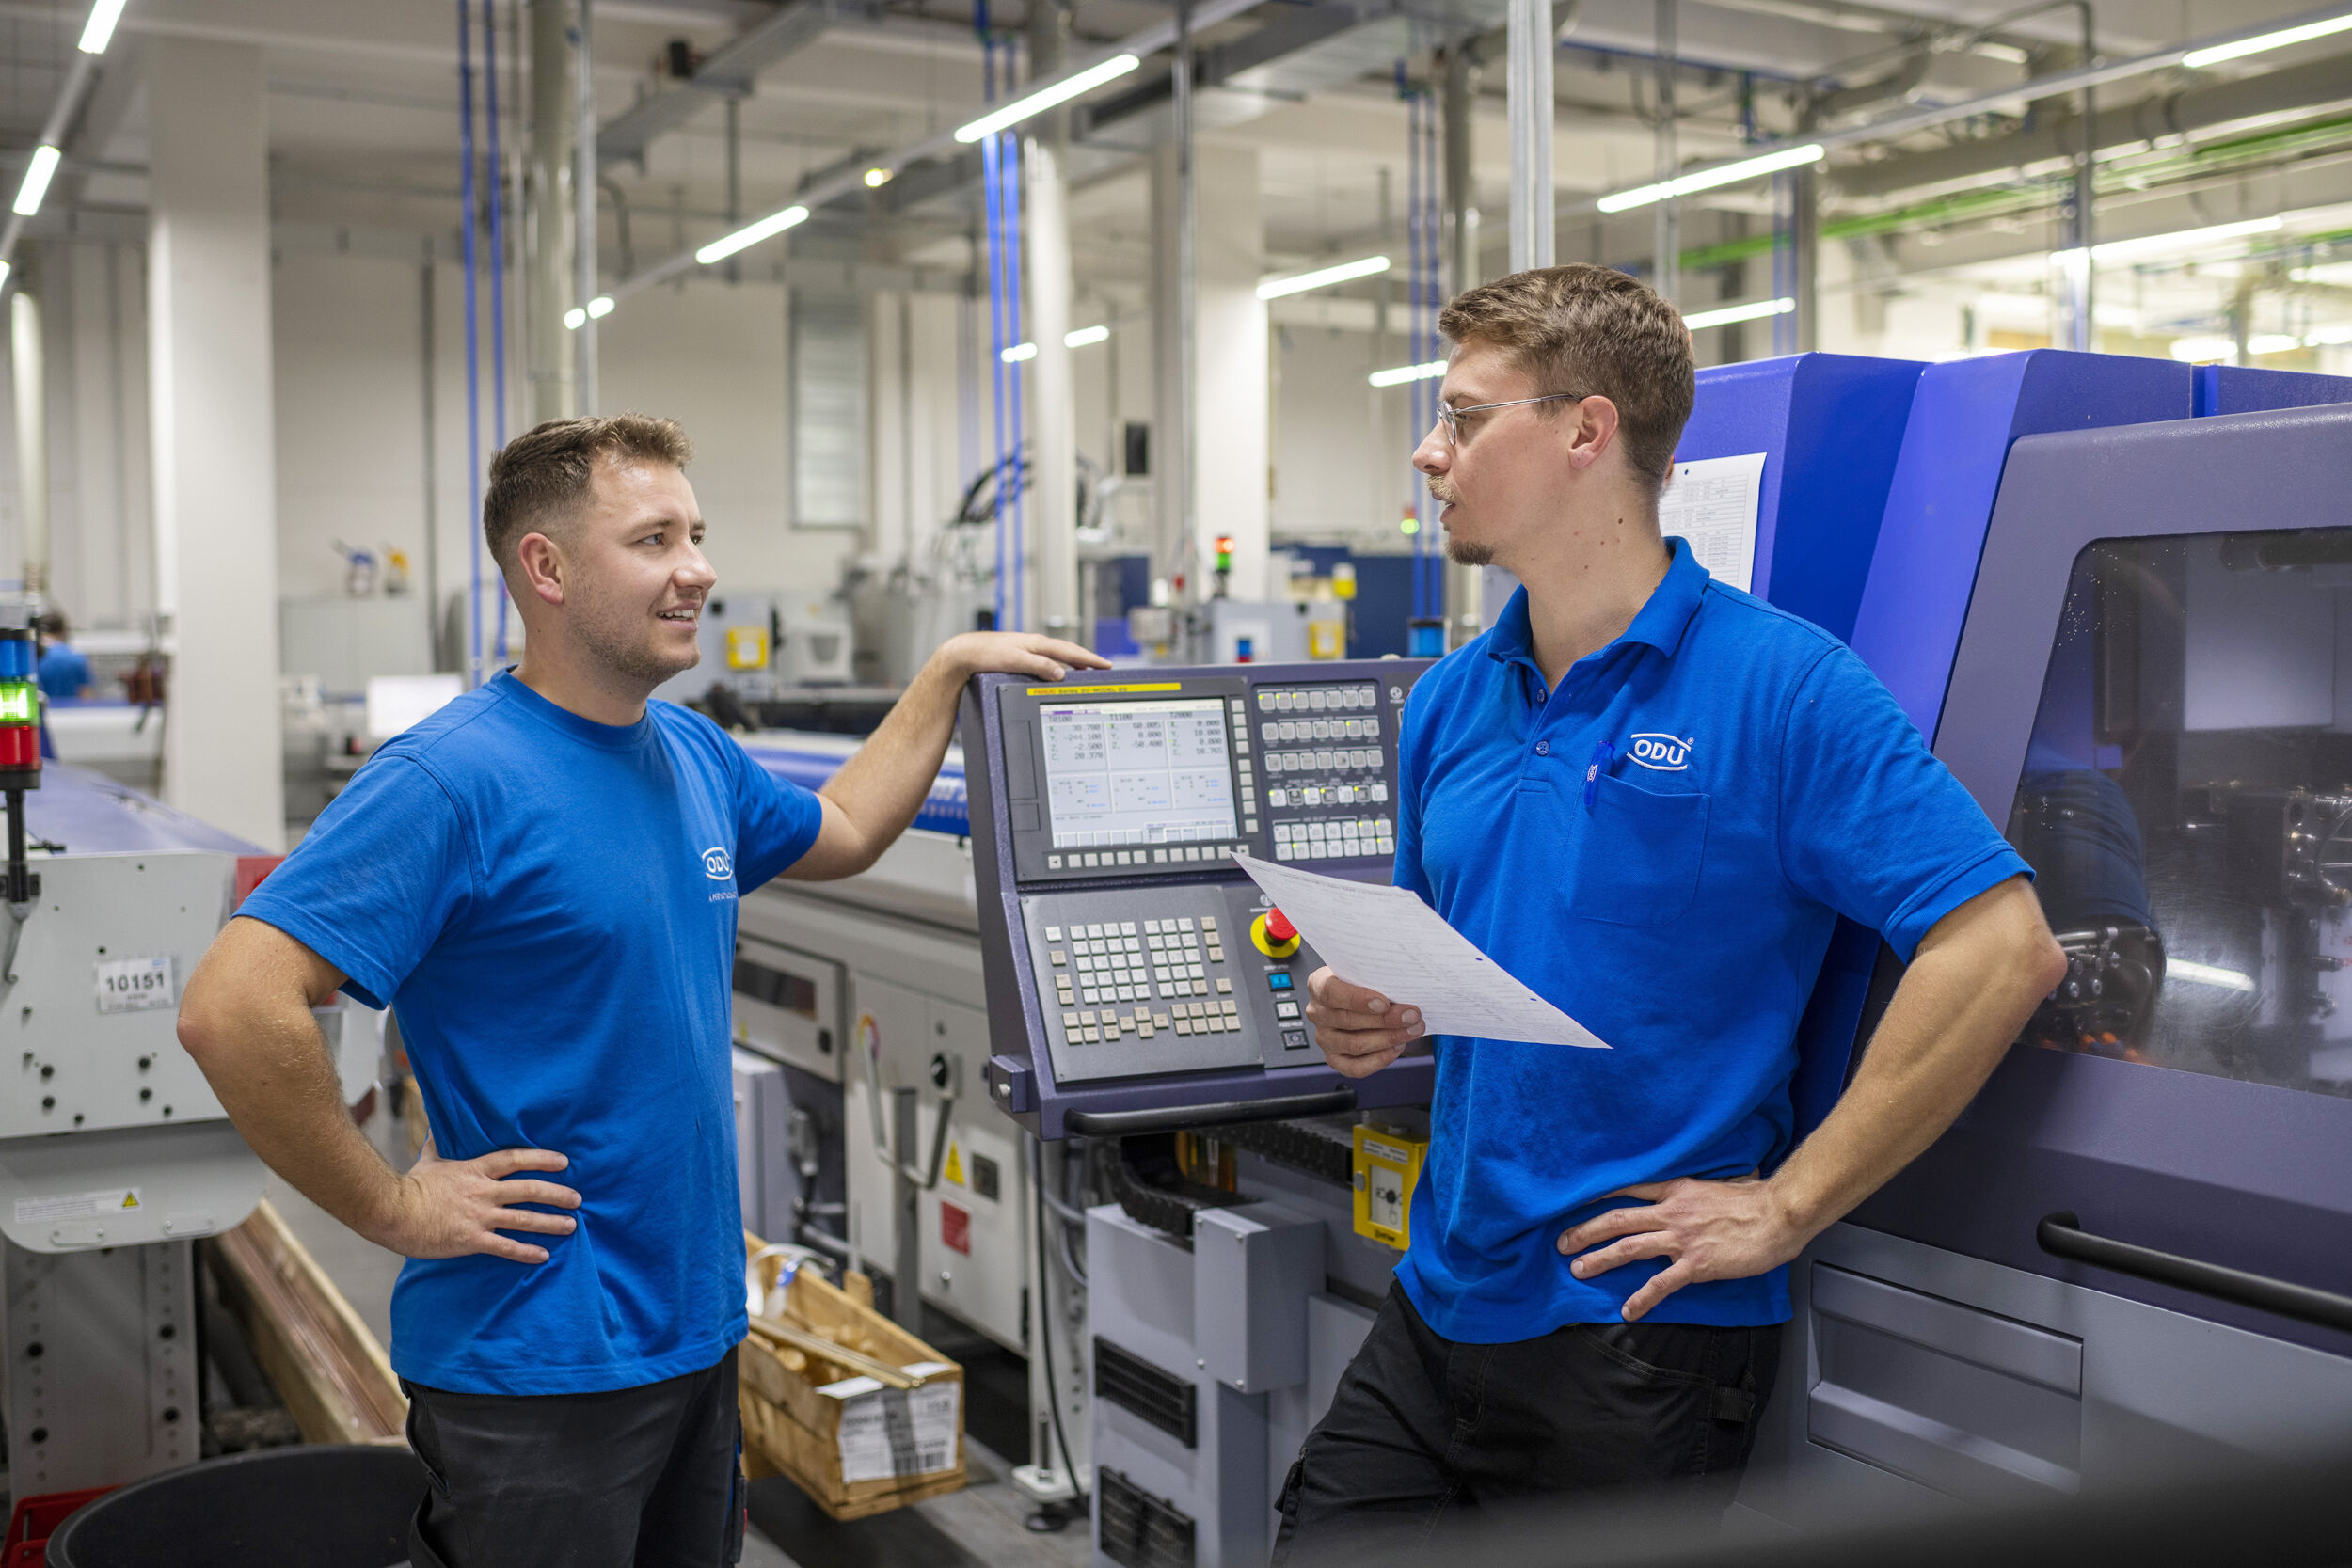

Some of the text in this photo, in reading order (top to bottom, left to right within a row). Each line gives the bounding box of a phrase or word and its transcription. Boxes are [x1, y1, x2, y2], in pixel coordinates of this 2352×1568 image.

[1634, 739, 1685, 765] ODU
[707, 856, 729, 873] ODU
[106, 970, 164, 992] 10151
